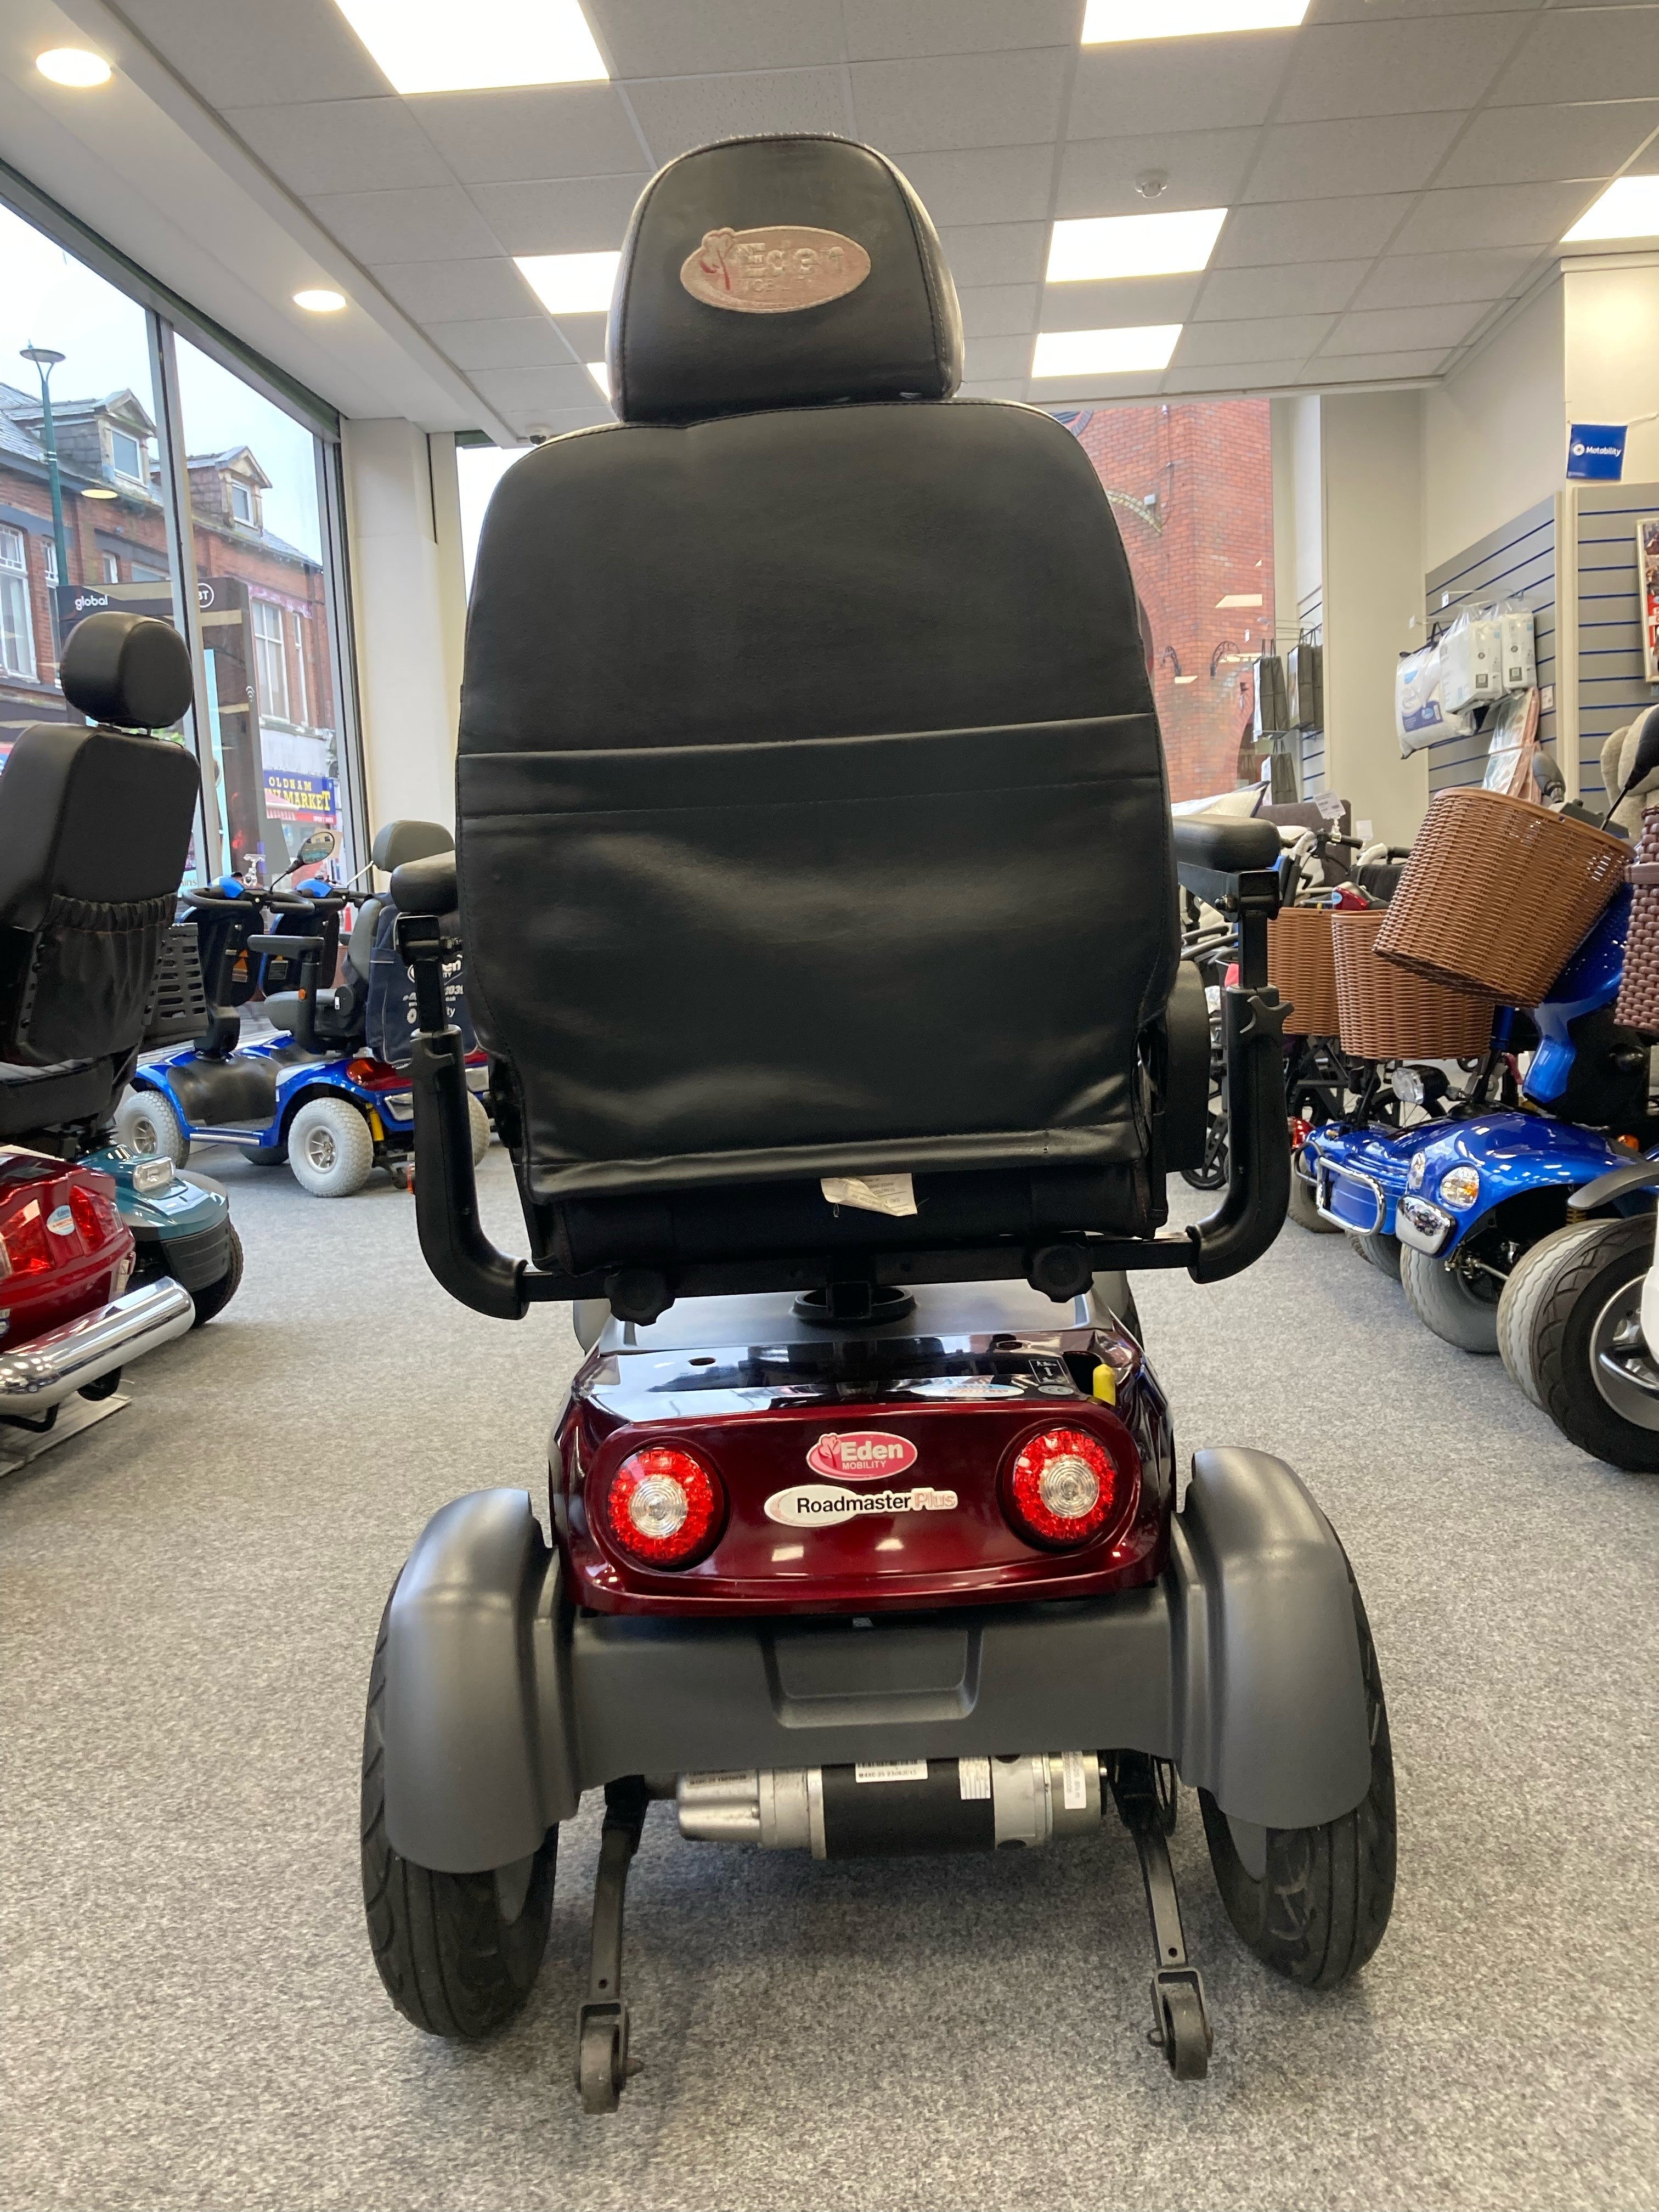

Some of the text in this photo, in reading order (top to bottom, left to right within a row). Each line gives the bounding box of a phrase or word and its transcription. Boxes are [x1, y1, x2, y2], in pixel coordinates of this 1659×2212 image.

[1586, 446, 1621, 458] Motability
[75, 594, 109, 611] global
[269, 776, 312, 791] OLDHAM
[283, 790, 330, 811] MARKET
[840, 1440, 904, 1462] Eden
[842, 1460, 887, 1470] MOBILITY
[797, 1491, 956, 1513] Roadmaster Plus
